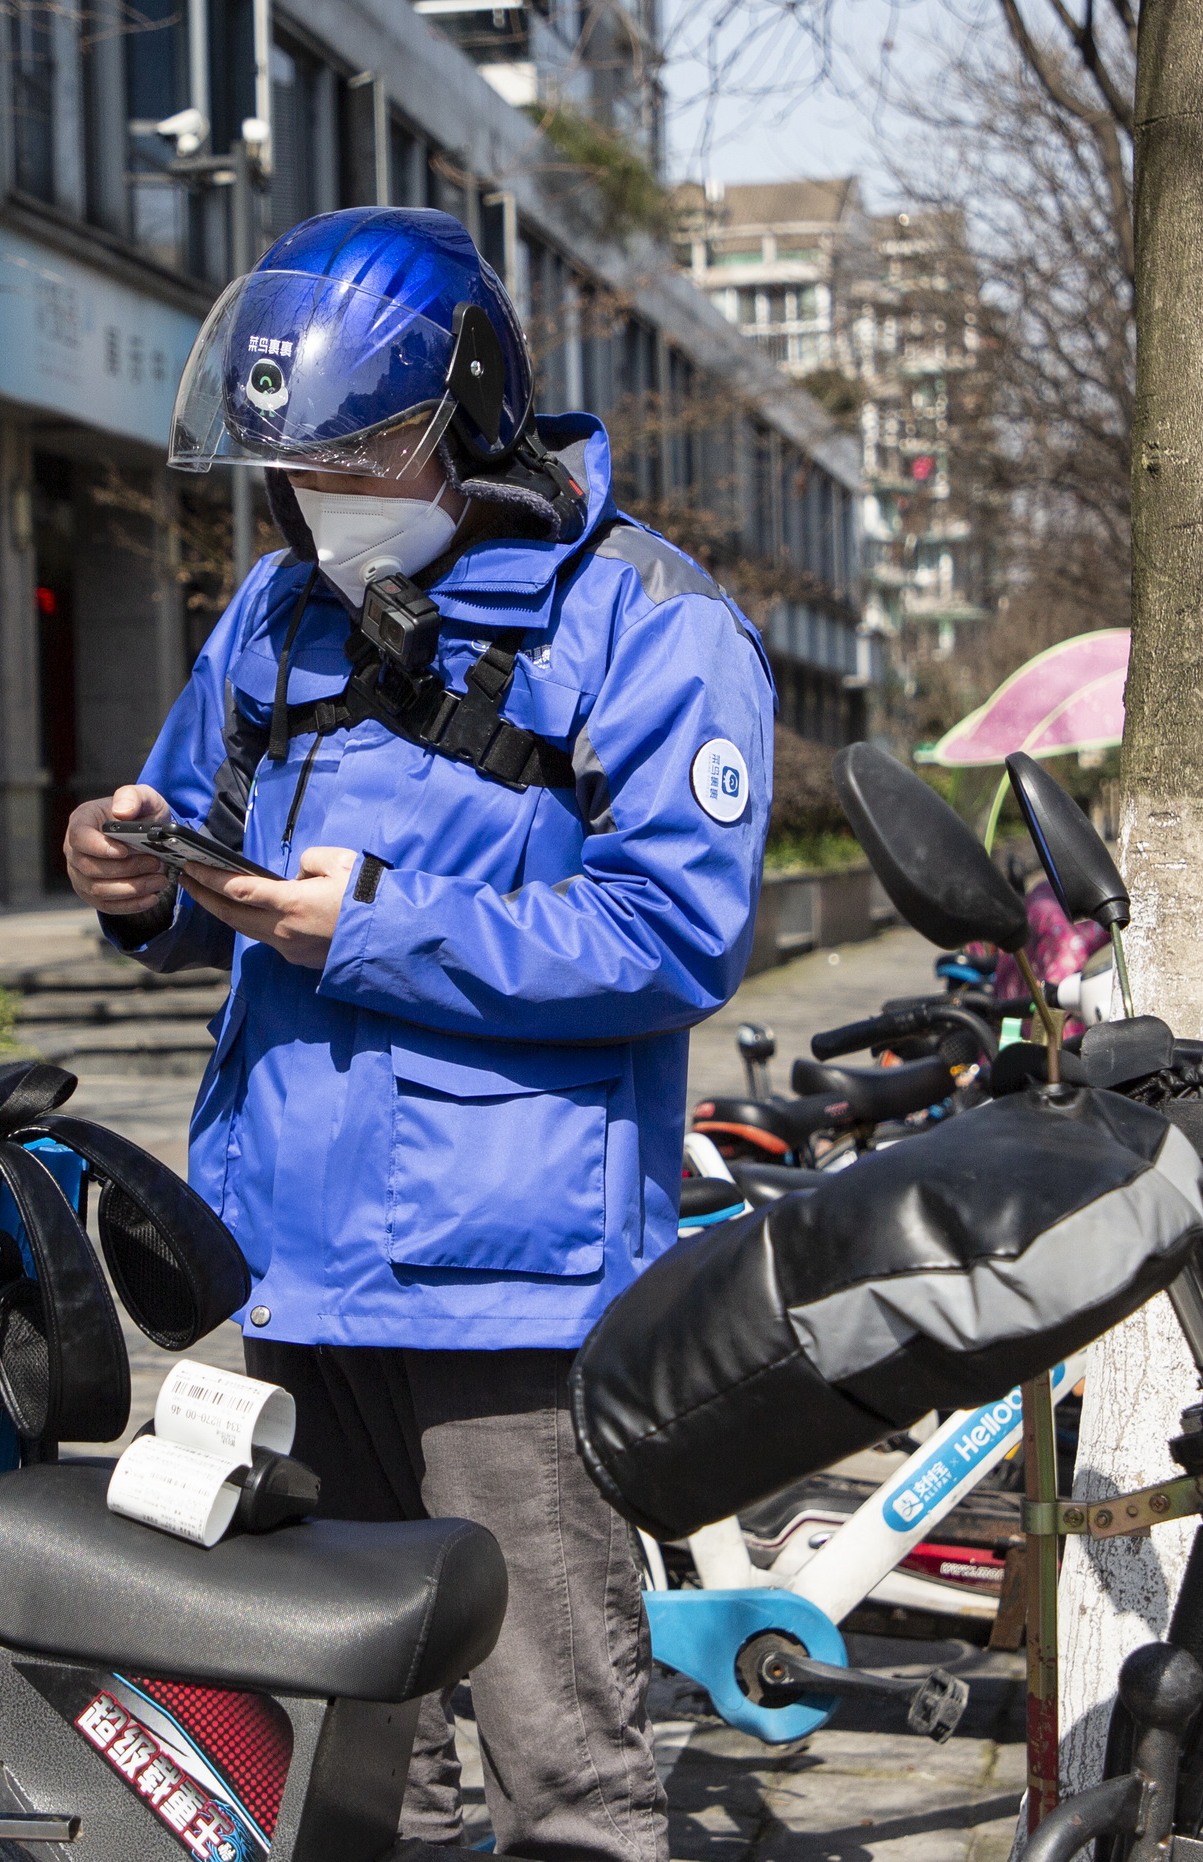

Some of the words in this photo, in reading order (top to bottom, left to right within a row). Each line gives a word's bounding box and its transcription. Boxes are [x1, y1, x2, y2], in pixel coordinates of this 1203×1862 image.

[248, 335, 293, 357] 菜鸟裹裹
[912, 1460, 949, 1498] 支付宝
[923, 1472, 954, 1503] ALIPAY
[75, 1693, 234, 1859] 超级载重王
